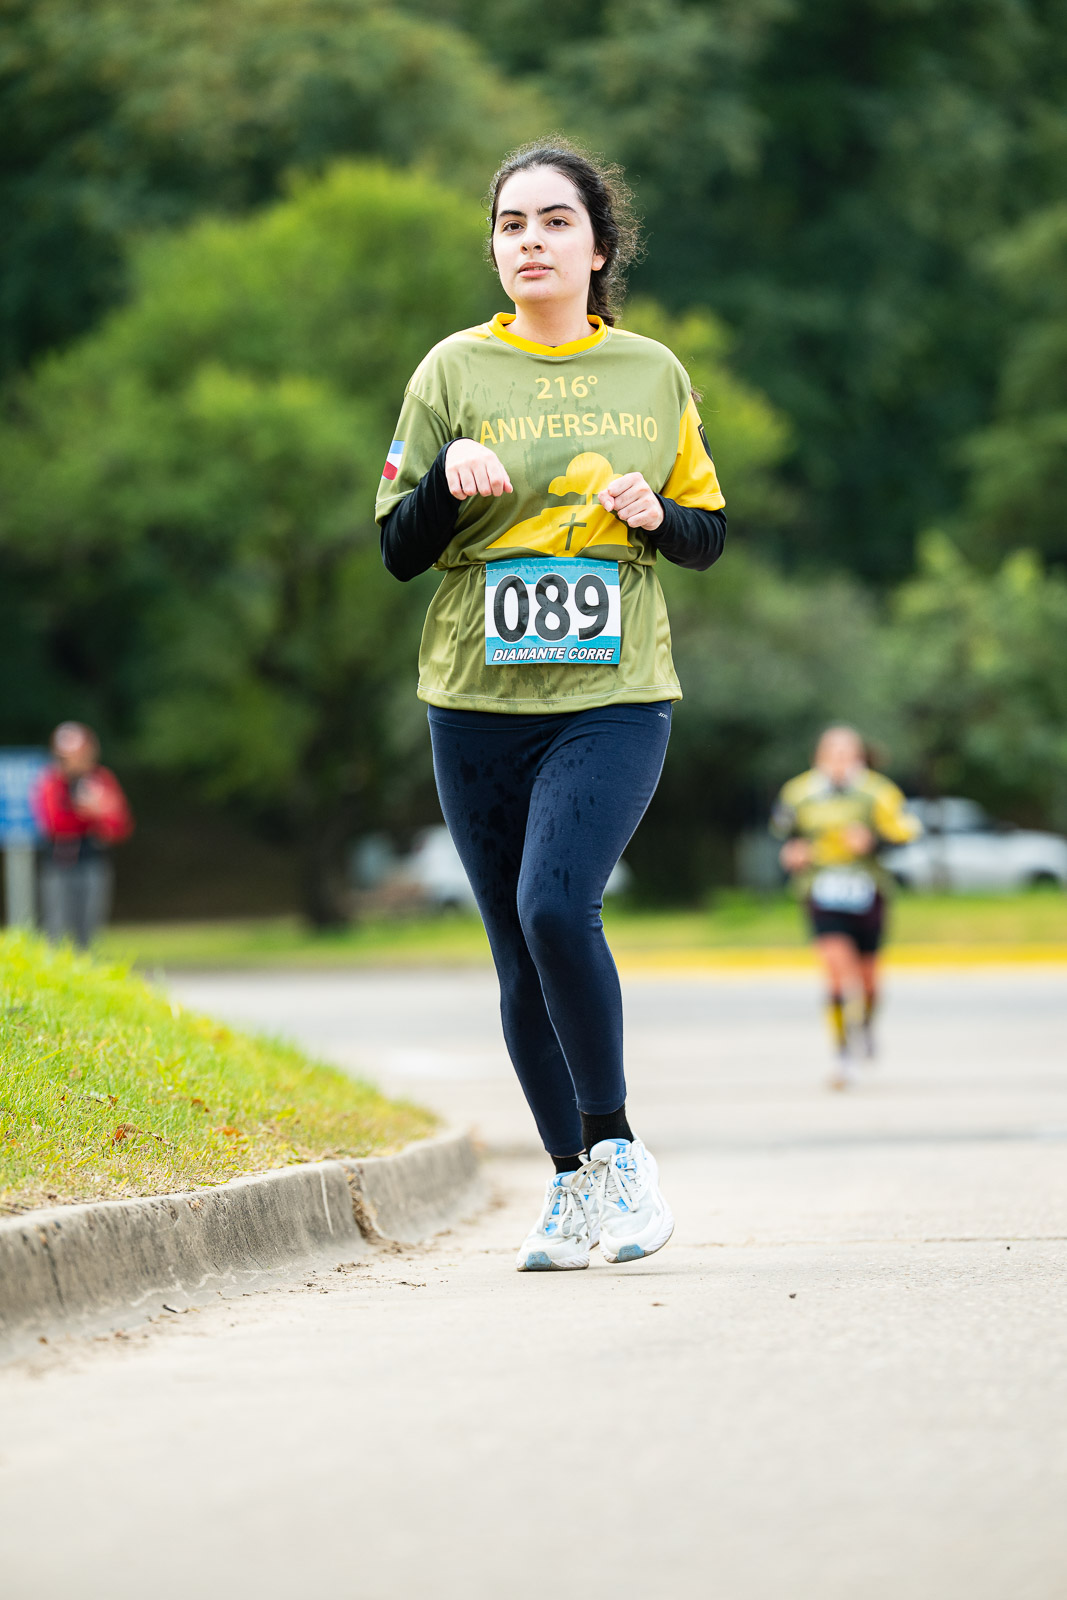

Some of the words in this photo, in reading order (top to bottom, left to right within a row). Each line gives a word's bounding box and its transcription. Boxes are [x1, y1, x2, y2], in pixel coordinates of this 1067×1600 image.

[480, 412, 658, 446] ANIVERSARIO
[493, 573, 610, 644] 089
[492, 647, 566, 662] DIAMANTE
[567, 648, 615, 661] CORRE
